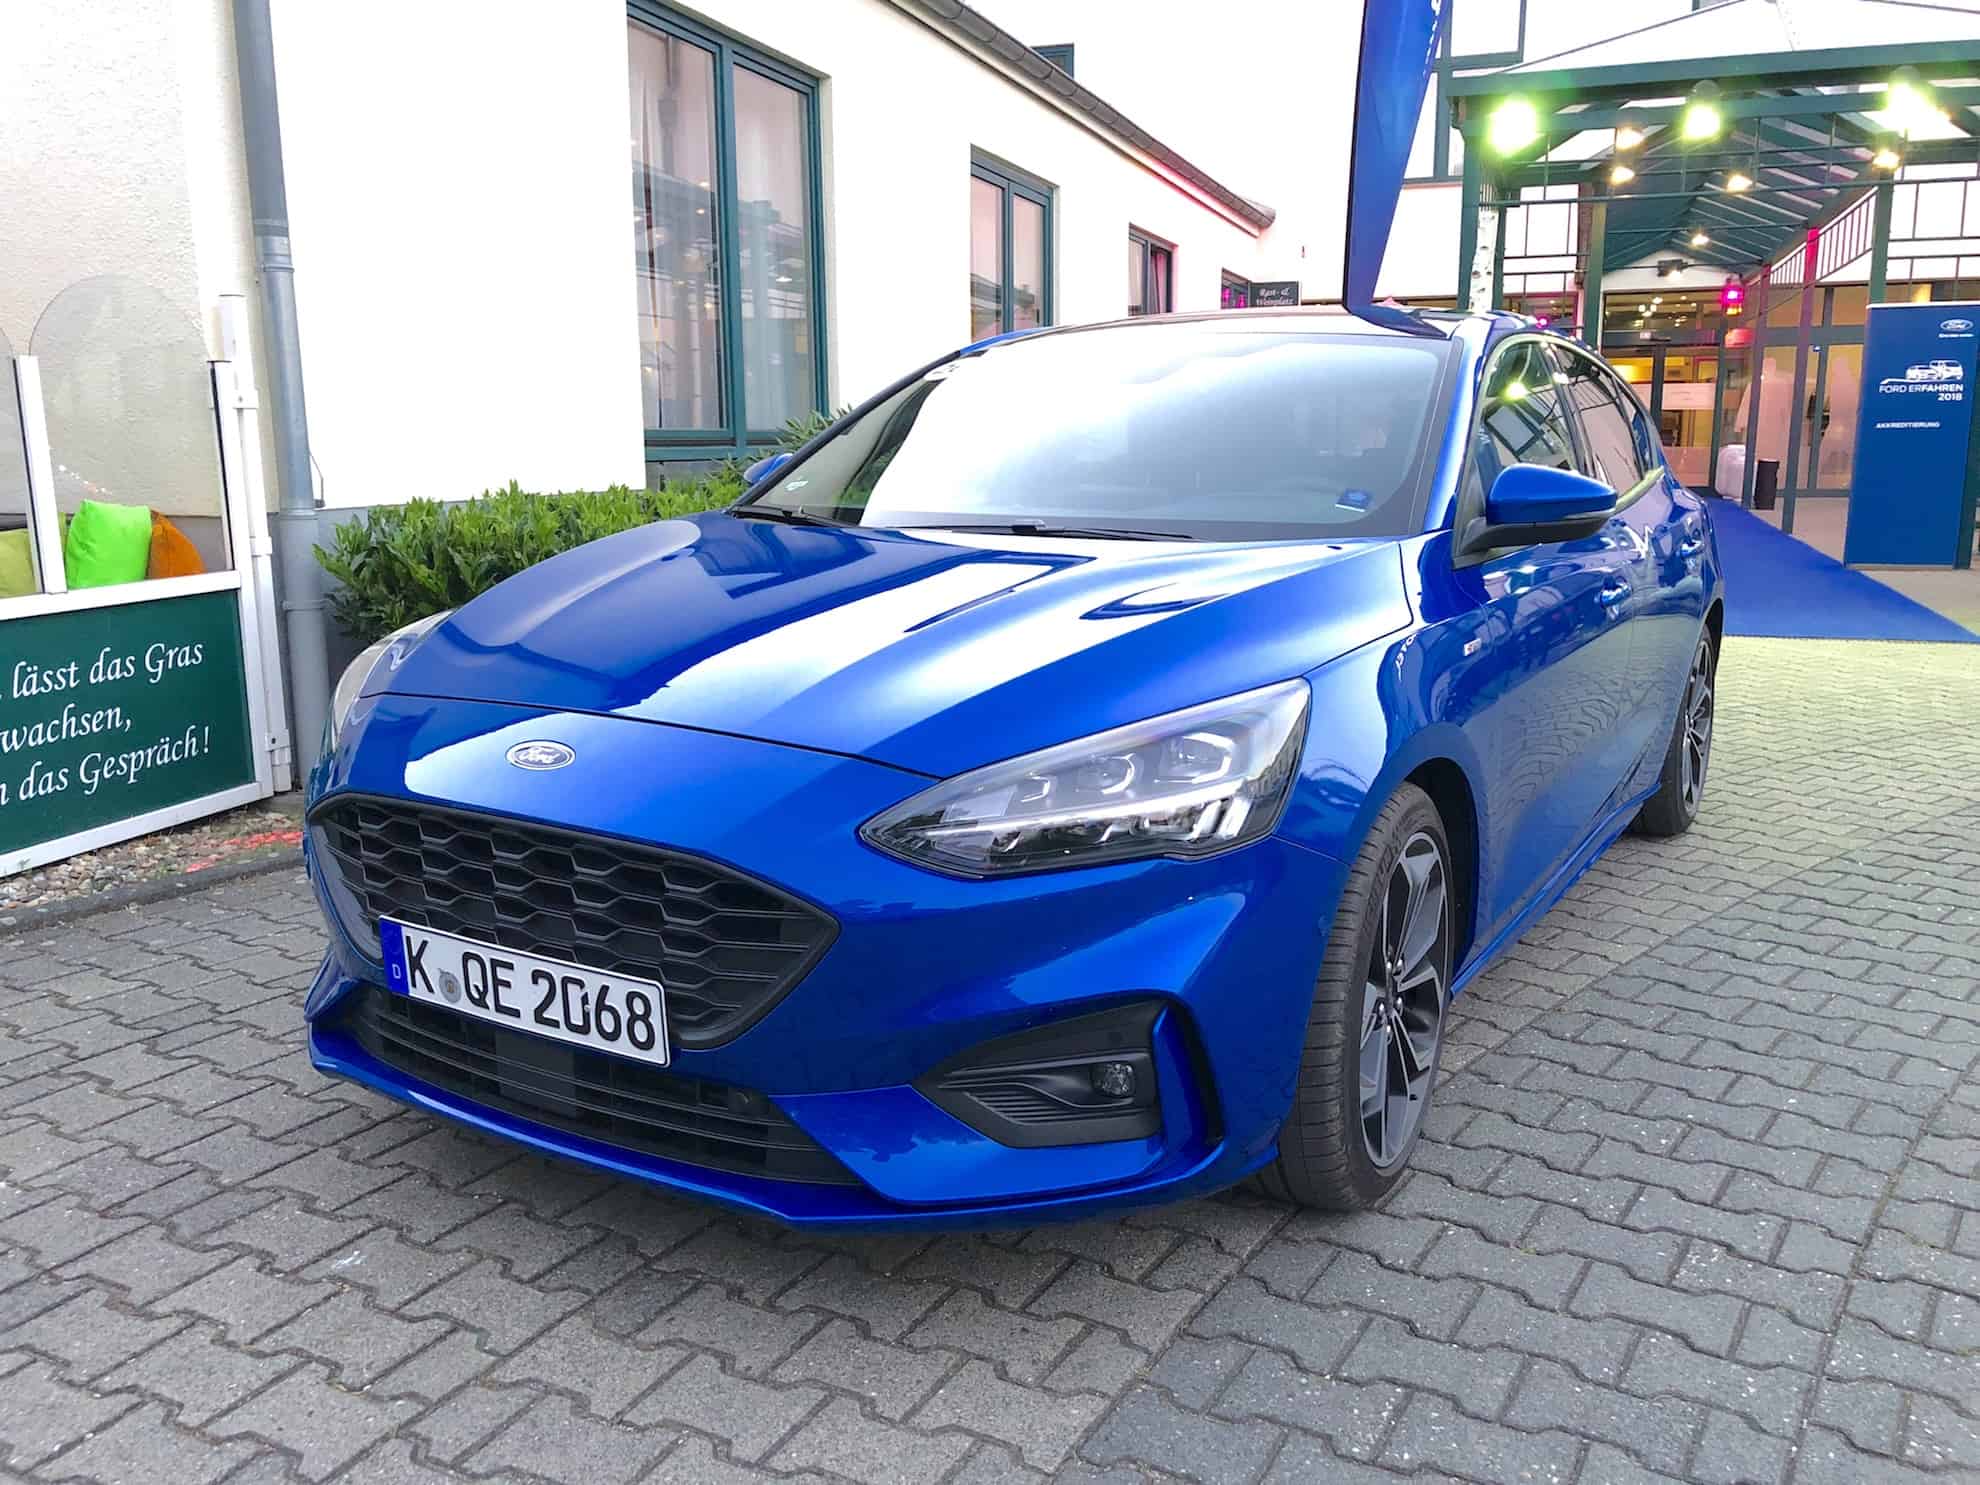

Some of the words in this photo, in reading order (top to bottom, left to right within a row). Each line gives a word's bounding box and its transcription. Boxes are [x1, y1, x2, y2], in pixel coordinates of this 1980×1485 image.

[1879, 384, 1907, 393] FORD
[1908, 383, 1964, 393] ERFAHREN
[1937, 393, 1963, 401] 2018
[12, 661, 80, 699] lässt
[89, 647, 136, 684] das
[144, 642, 204, 684] Gras
[18, 761, 70, 801] das
[391, 963, 402, 979] D
[405, 935, 435, 994] K
[462, 951, 521, 1019] QE
[531, 969, 656, 1051] 2068
